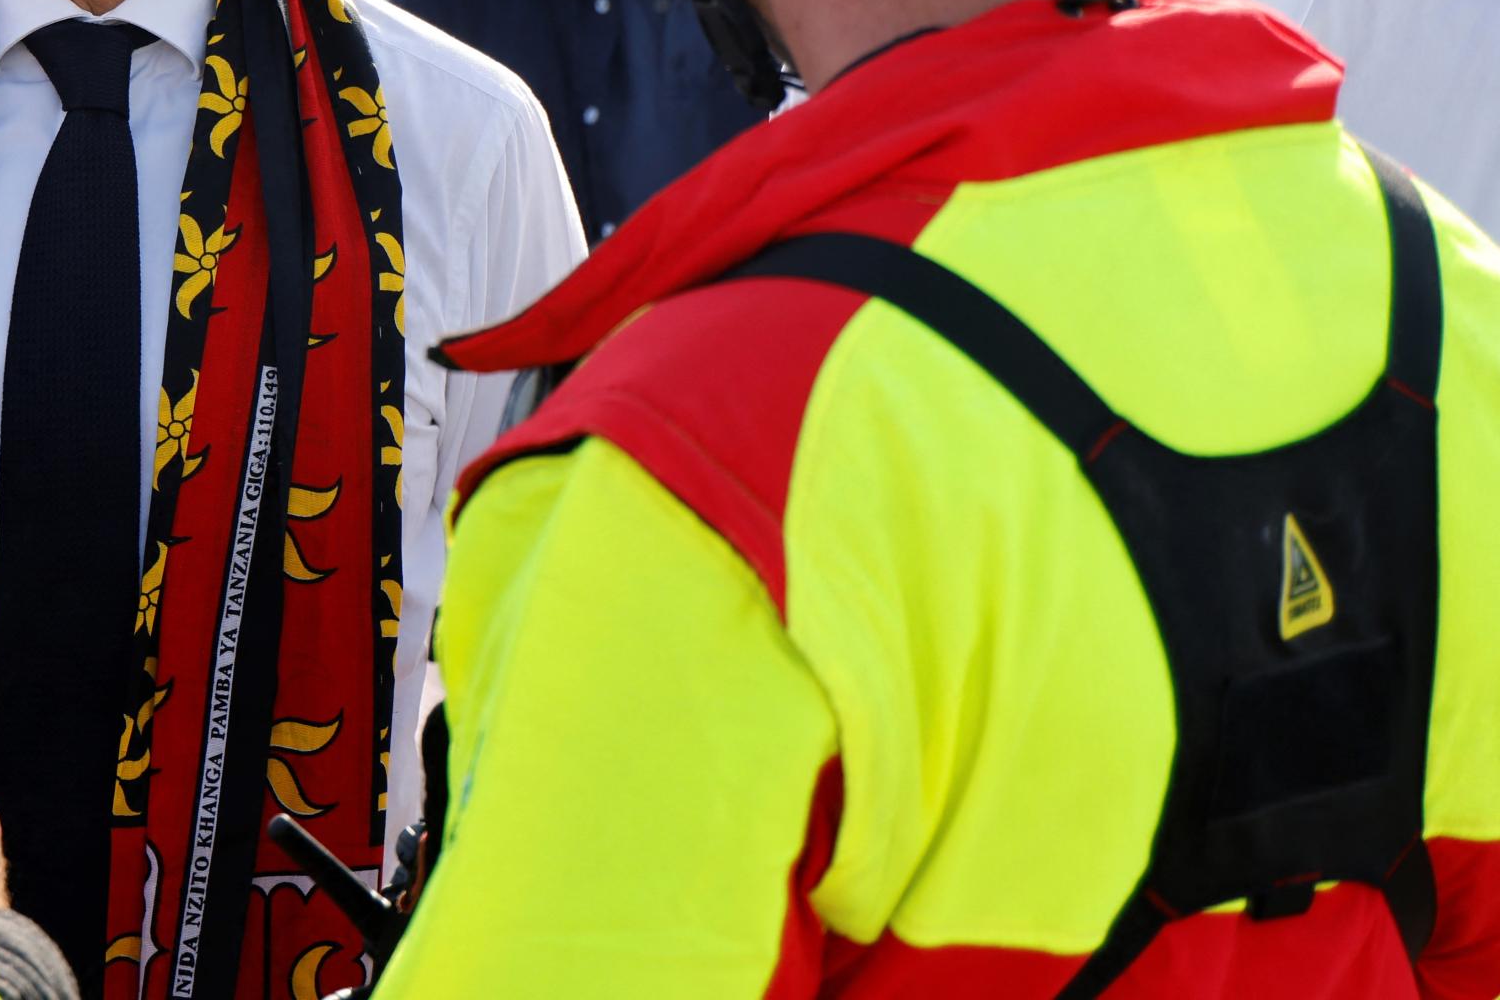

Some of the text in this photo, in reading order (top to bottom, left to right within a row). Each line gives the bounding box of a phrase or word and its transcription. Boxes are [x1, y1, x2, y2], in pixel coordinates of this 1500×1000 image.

[225, 507, 258, 618] TANZANIA
[219, 628, 238, 656] YA
[211, 663, 234, 740] PAMBA
[197, 753, 224, 848] KHANGA
[185, 856, 209, 927] NZITO
[176, 936, 199, 995] NIDA
